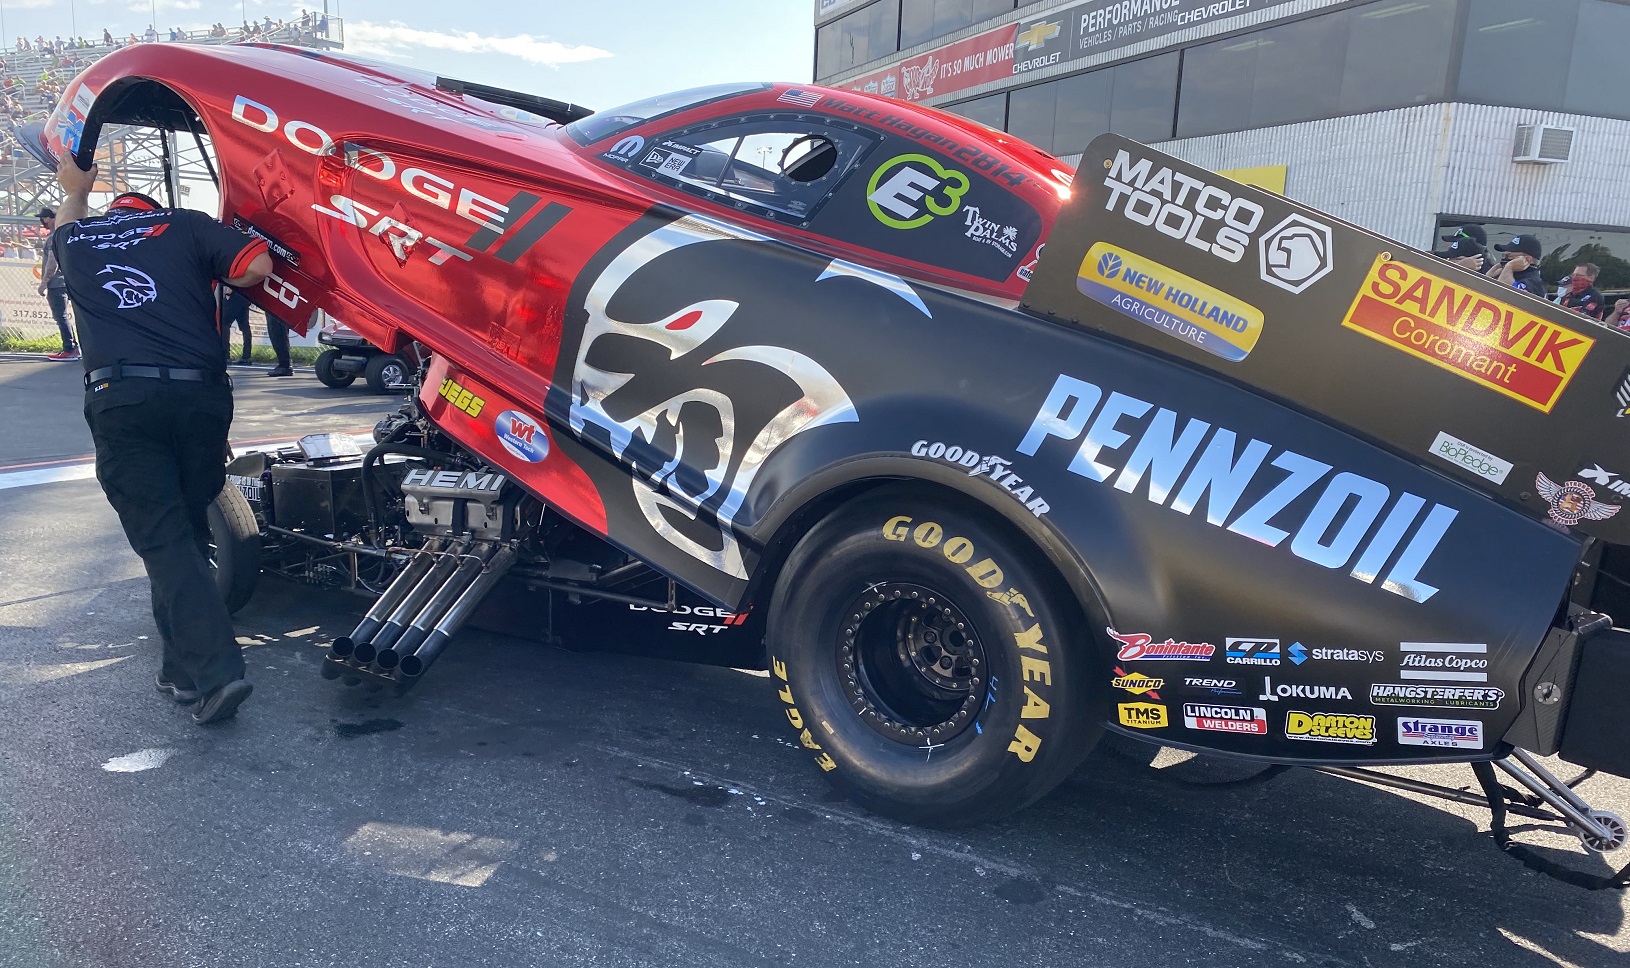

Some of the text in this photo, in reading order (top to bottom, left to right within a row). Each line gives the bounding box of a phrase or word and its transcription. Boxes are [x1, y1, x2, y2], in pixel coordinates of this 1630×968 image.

[1079, 32, 1111, 49] VEHICLES
[1118, 21, 1142, 37] PARTS
[1148, 10, 1178, 29] RACING
[953, 59, 962, 75] SO
[963, 51, 984, 72] MUCH
[985, 43, 1014, 64] MOWER
[1012, 52, 1061, 74] CHEVROLET
[820, 96, 960, 150] Matt Hagan
[232, 94, 510, 235] DODGE
[664, 162, 681, 171] ERA
[671, 157, 686, 166] NEW
[867, 160, 970, 224] E3
[1107, 148, 1264, 233] MATCO
[311, 194, 473, 265] SRT
[1104, 177, 1250, 263] TOOLS
[1121, 267, 1249, 334] NEW HOLLAND
[1111, 294, 1207, 343] AGRICULTURE
[1371, 263, 1586, 374] SANDVIK
[1391, 317, 1518, 384] Coromant
[439, 378, 486, 418] JEGS
[503, 433, 523, 447] Western
[403, 469, 504, 492] HEMI
[1016, 373, 1459, 605] PENNZOIL
[668, 622, 728, 635] SRT
[1226, 657, 1280, 666] CARRILLO
[1312, 647, 1384, 663] stratasys
[1400, 654, 1488, 671] Atlas Copco
[1113, 678, 1163, 688] SUNOCO
[1184, 678, 1236, 687] TREND
[1276, 685, 1352, 700] OKUMA
[1372, 686, 1497, 701] HANGSTERFER'S
[1375, 697, 1435, 705] METALWORKING
[772, 656, 837, 772] EAGLE
[1124, 707, 1161, 720] TMS
[1186, 705, 1251, 720] LINCOLN
[1202, 720, 1259, 732] WELDERS
[1288, 713, 1373, 734] DARTON
[1311, 727, 1373, 739] SLEEVES
[1402, 720, 1478, 737] Strange
